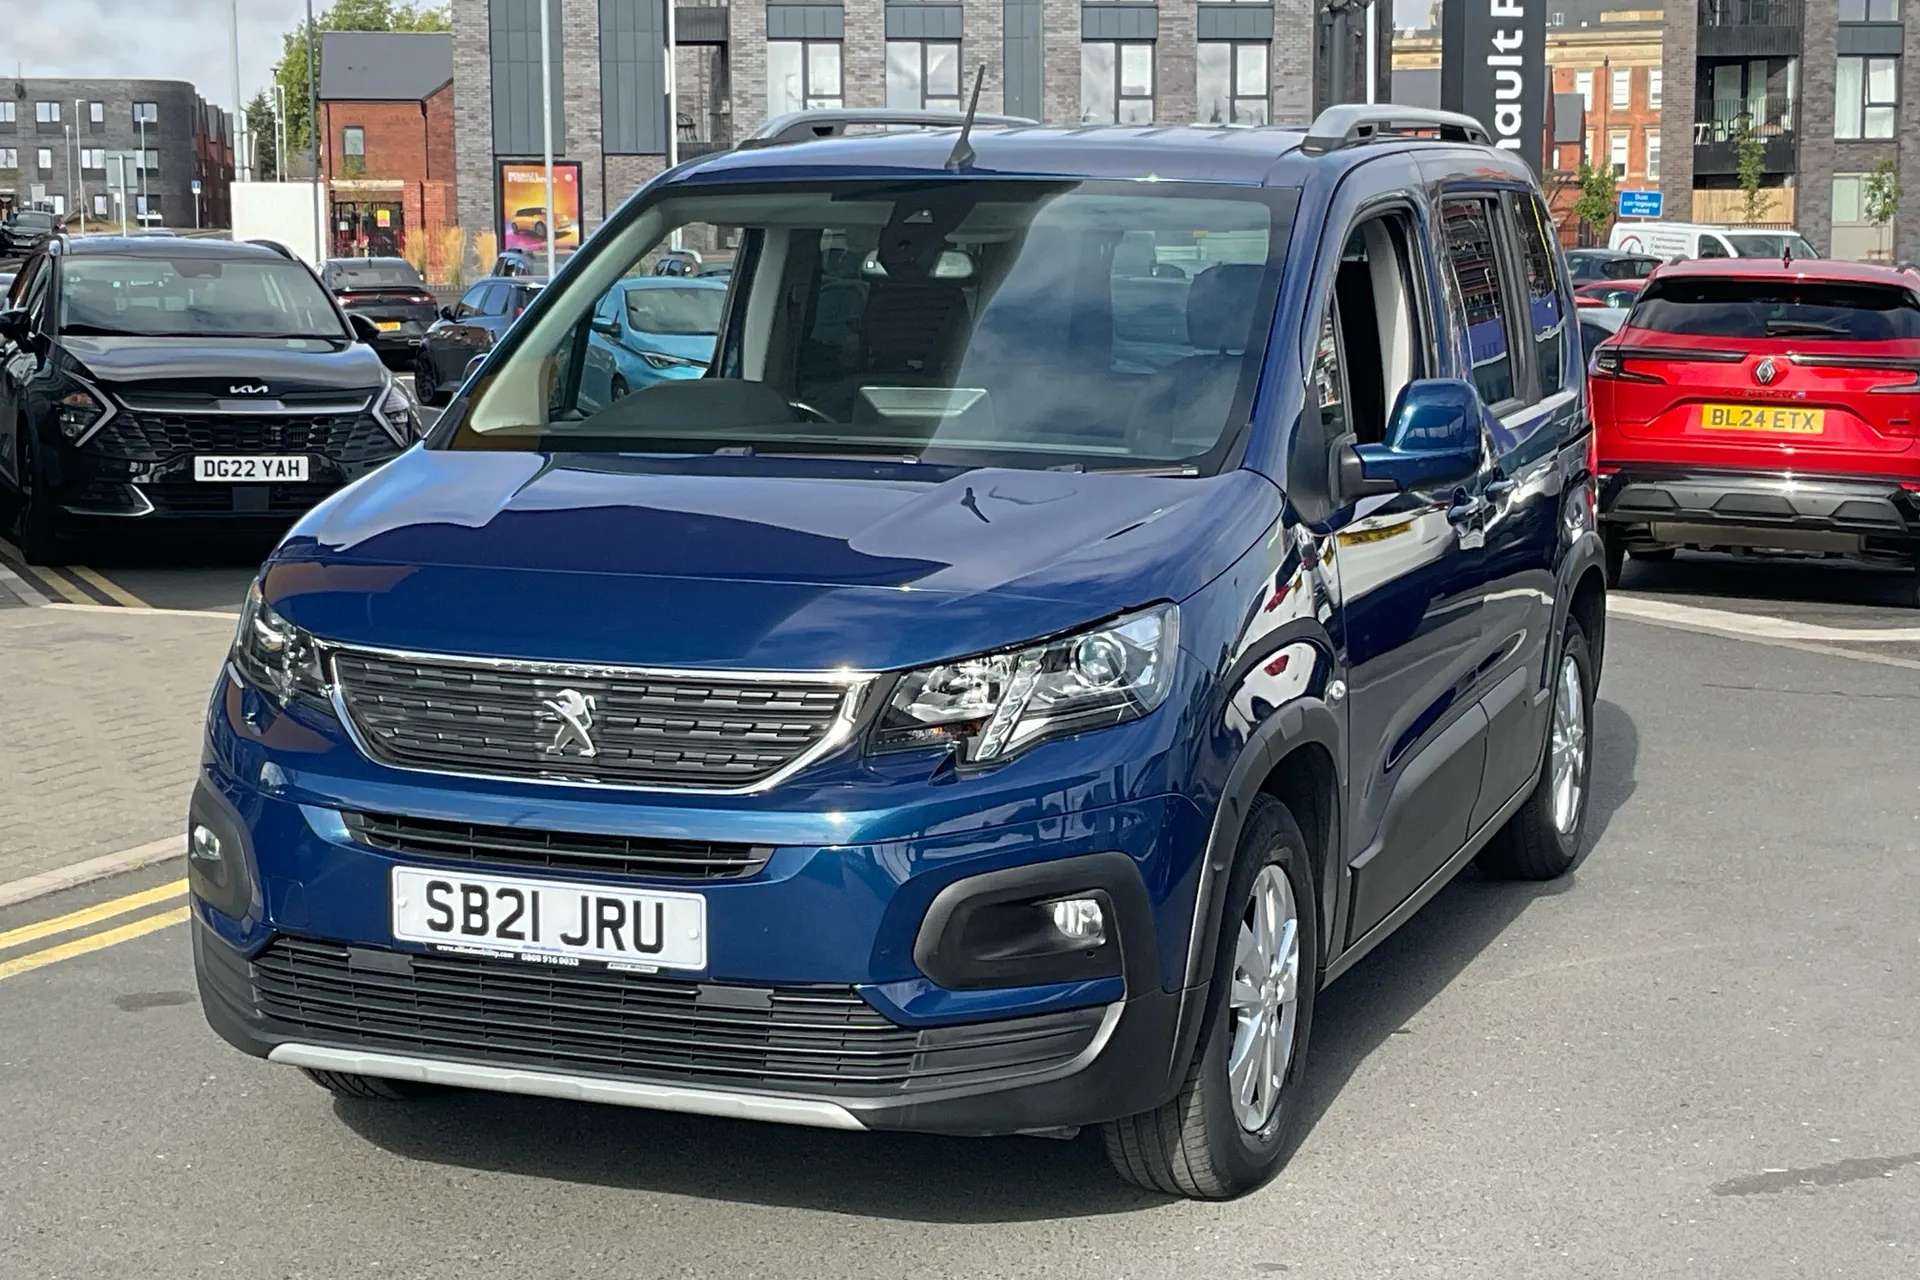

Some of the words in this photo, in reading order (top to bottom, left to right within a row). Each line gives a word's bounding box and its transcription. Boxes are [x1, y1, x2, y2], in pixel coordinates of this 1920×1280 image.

[1711, 408, 1766, 427] BL24
[1773, 411, 1815, 430] ETX
[204, 460, 256, 477] DG22
[262, 460, 300, 477] YAH
[426, 880, 540, 942] SB21
[560, 895, 663, 954] JRU
